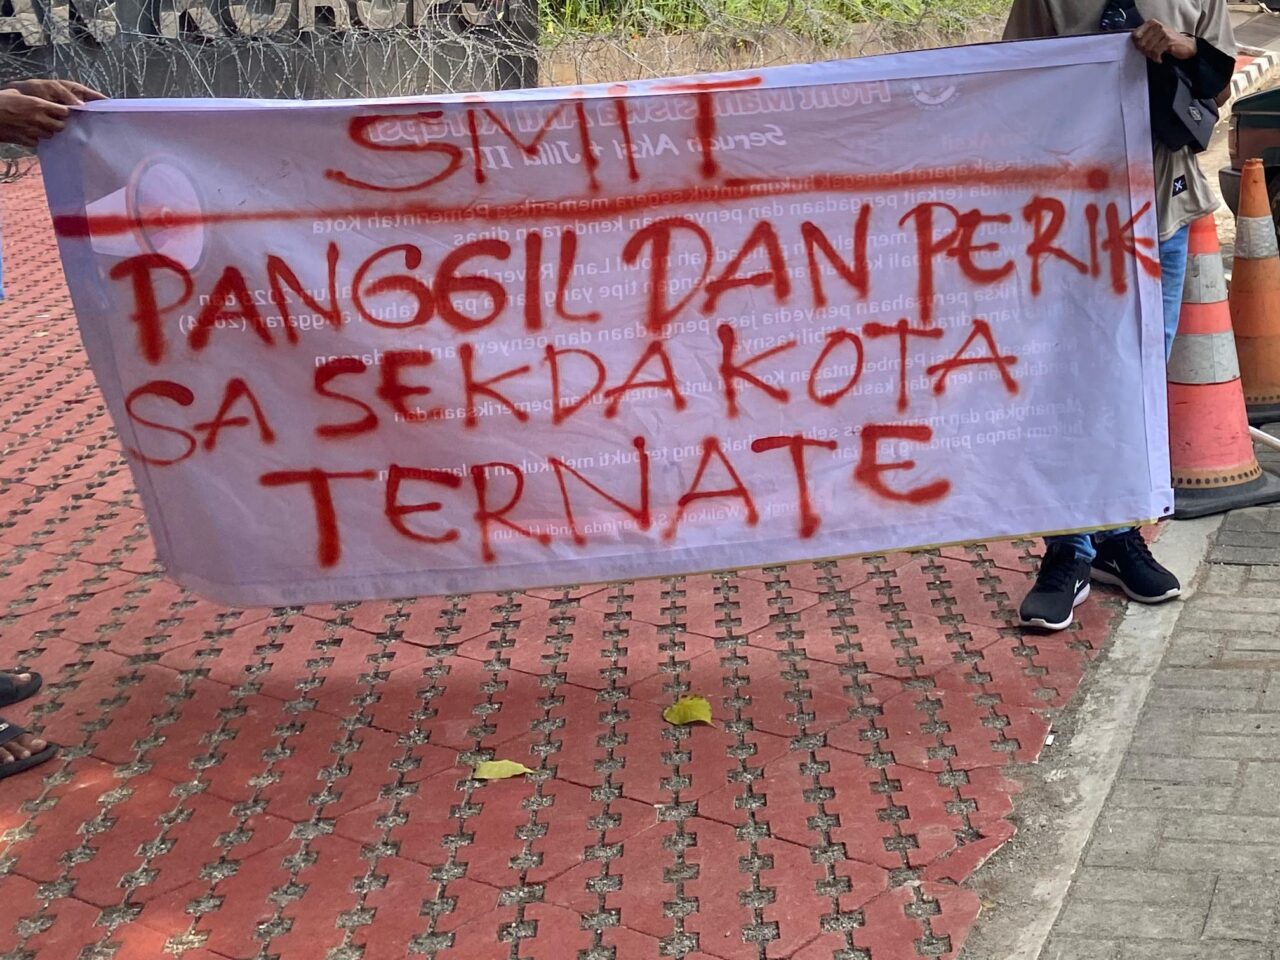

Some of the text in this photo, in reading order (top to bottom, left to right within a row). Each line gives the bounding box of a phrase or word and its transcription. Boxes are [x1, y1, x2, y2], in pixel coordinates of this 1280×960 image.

[325, 75, 764, 192] SMIT
[110, 195, 1162, 365] PANGGIL DAN PERIK
[123, 377, 275, 467] SA
[259, 425, 952, 568] TERNATE
